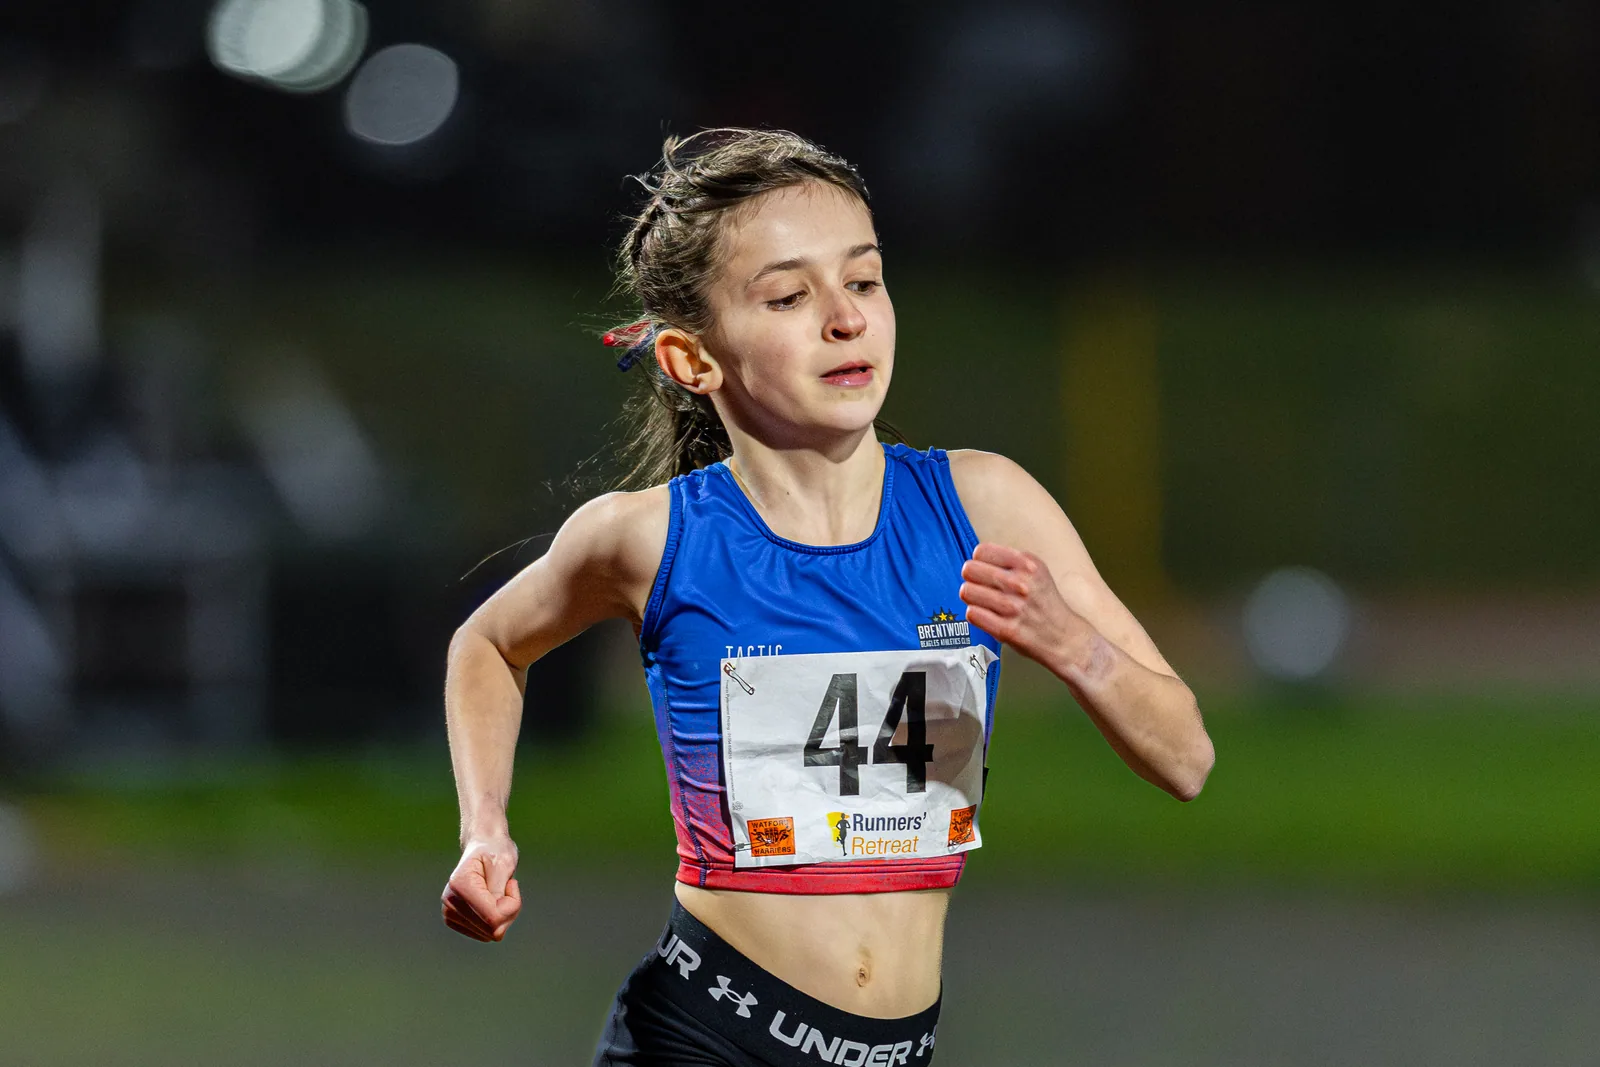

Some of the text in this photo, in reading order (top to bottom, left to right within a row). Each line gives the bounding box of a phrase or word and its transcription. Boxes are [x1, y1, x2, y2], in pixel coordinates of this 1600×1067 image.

[917, 621, 970, 640] BRENTWOOD
[725, 644, 782, 659] TACTIC
[920, 636, 971, 648] BEAGLES ATHLETICS CLUB
[804, 672, 934, 796] 44
[853, 811, 927, 832] Runners'
[754, 846, 792, 855] HARRIERS
[851, 835, 919, 855] Retreat
[768, 1009, 913, 1067] UNDER
